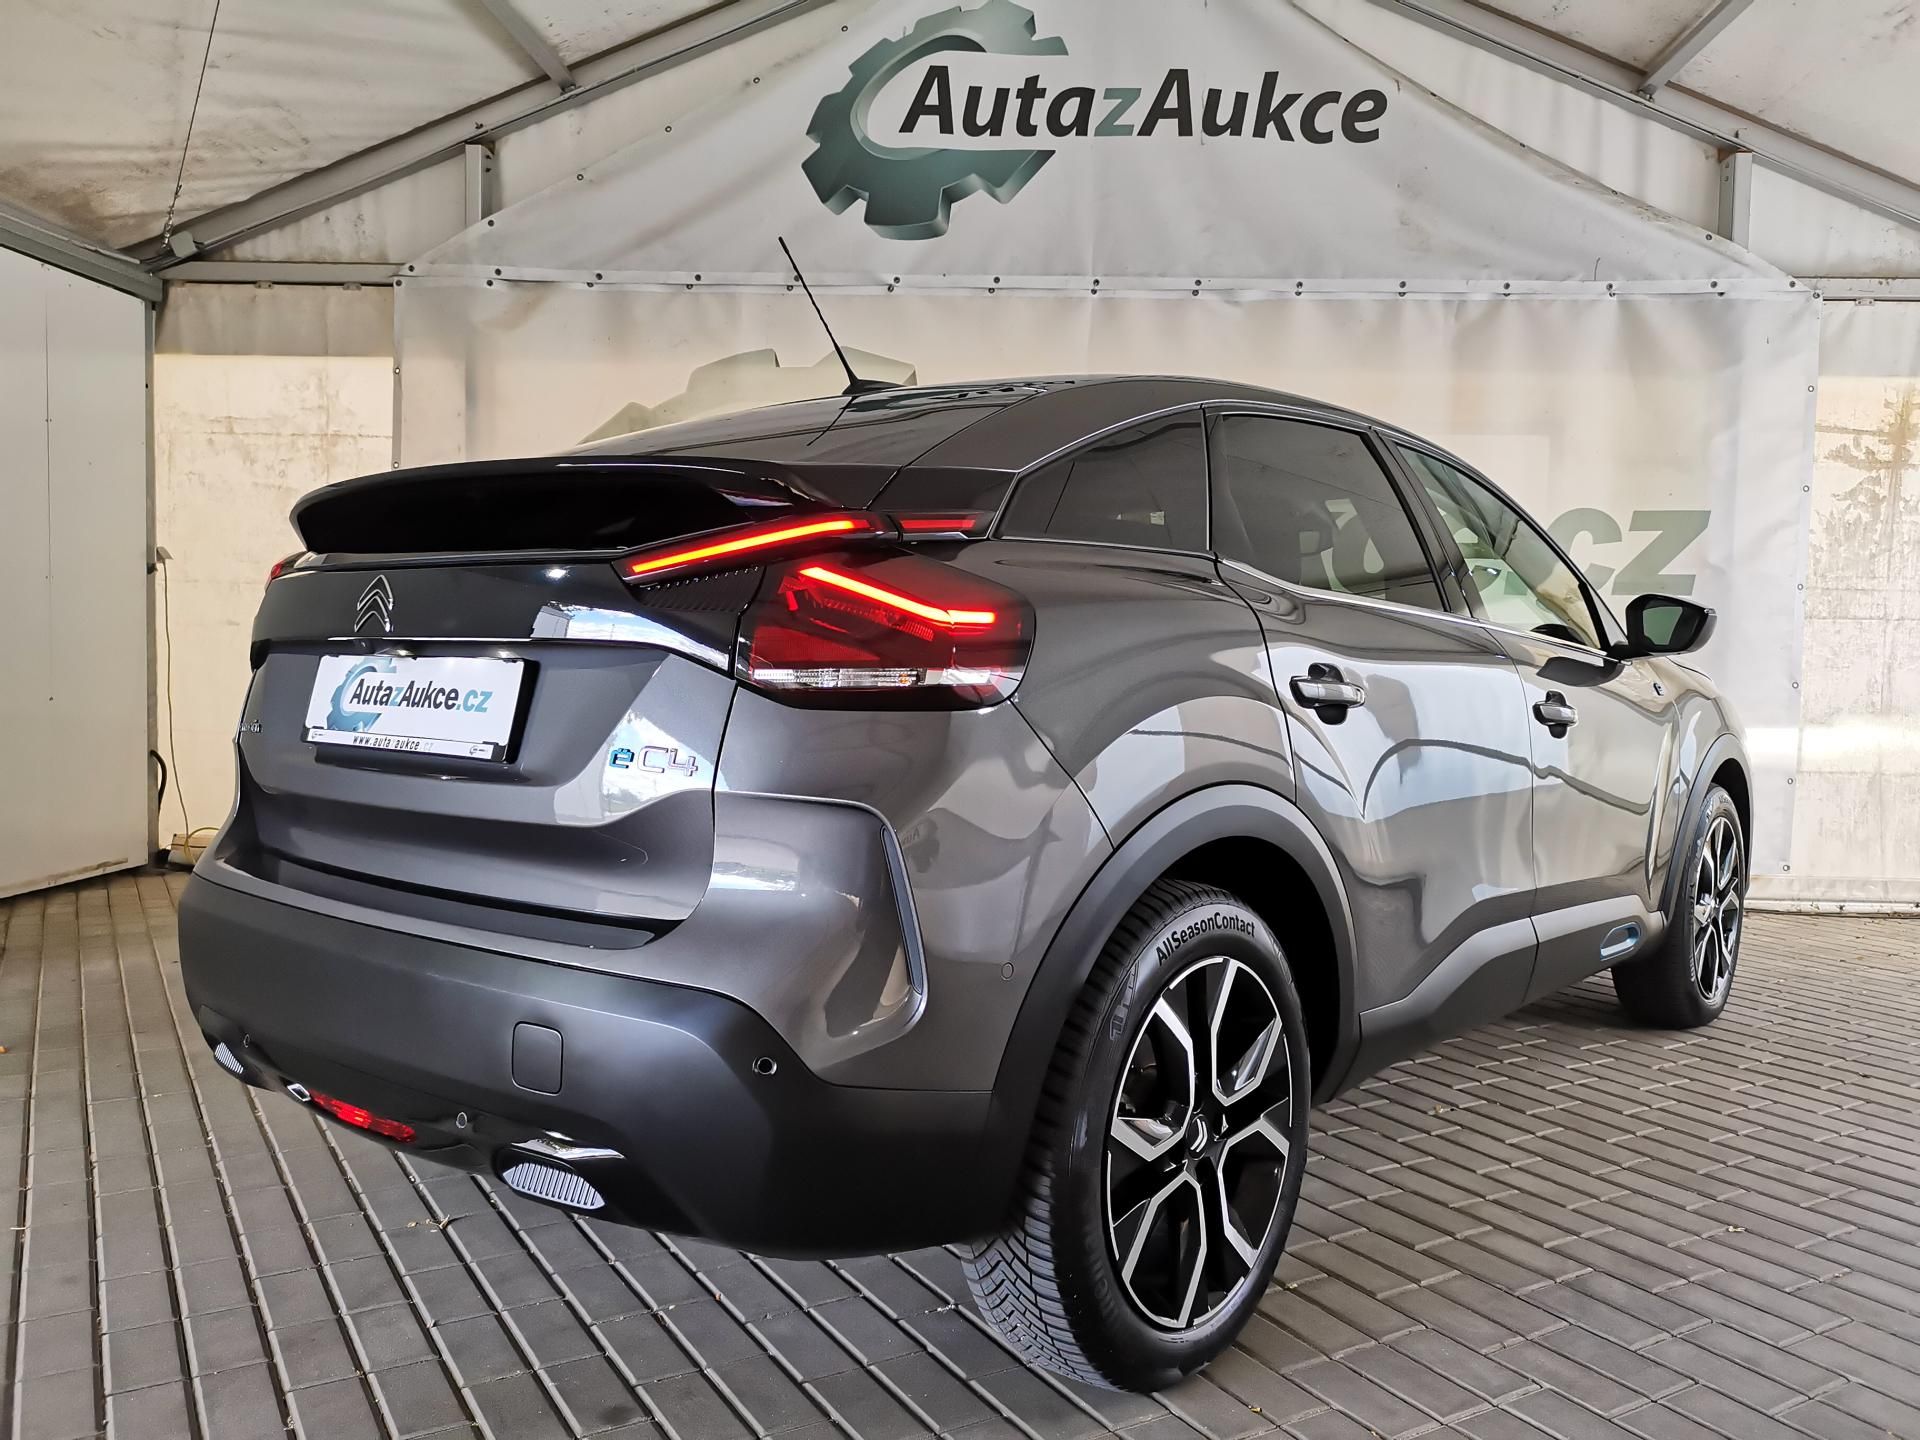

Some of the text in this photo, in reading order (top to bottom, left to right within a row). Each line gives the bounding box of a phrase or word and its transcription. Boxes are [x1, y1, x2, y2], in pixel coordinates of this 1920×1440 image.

[899, 65, 1388, 144] AutazAukce
[349, 678, 493, 713] AutazAukce.cz
[1156, 912, 1255, 966] AllSeasonContact
